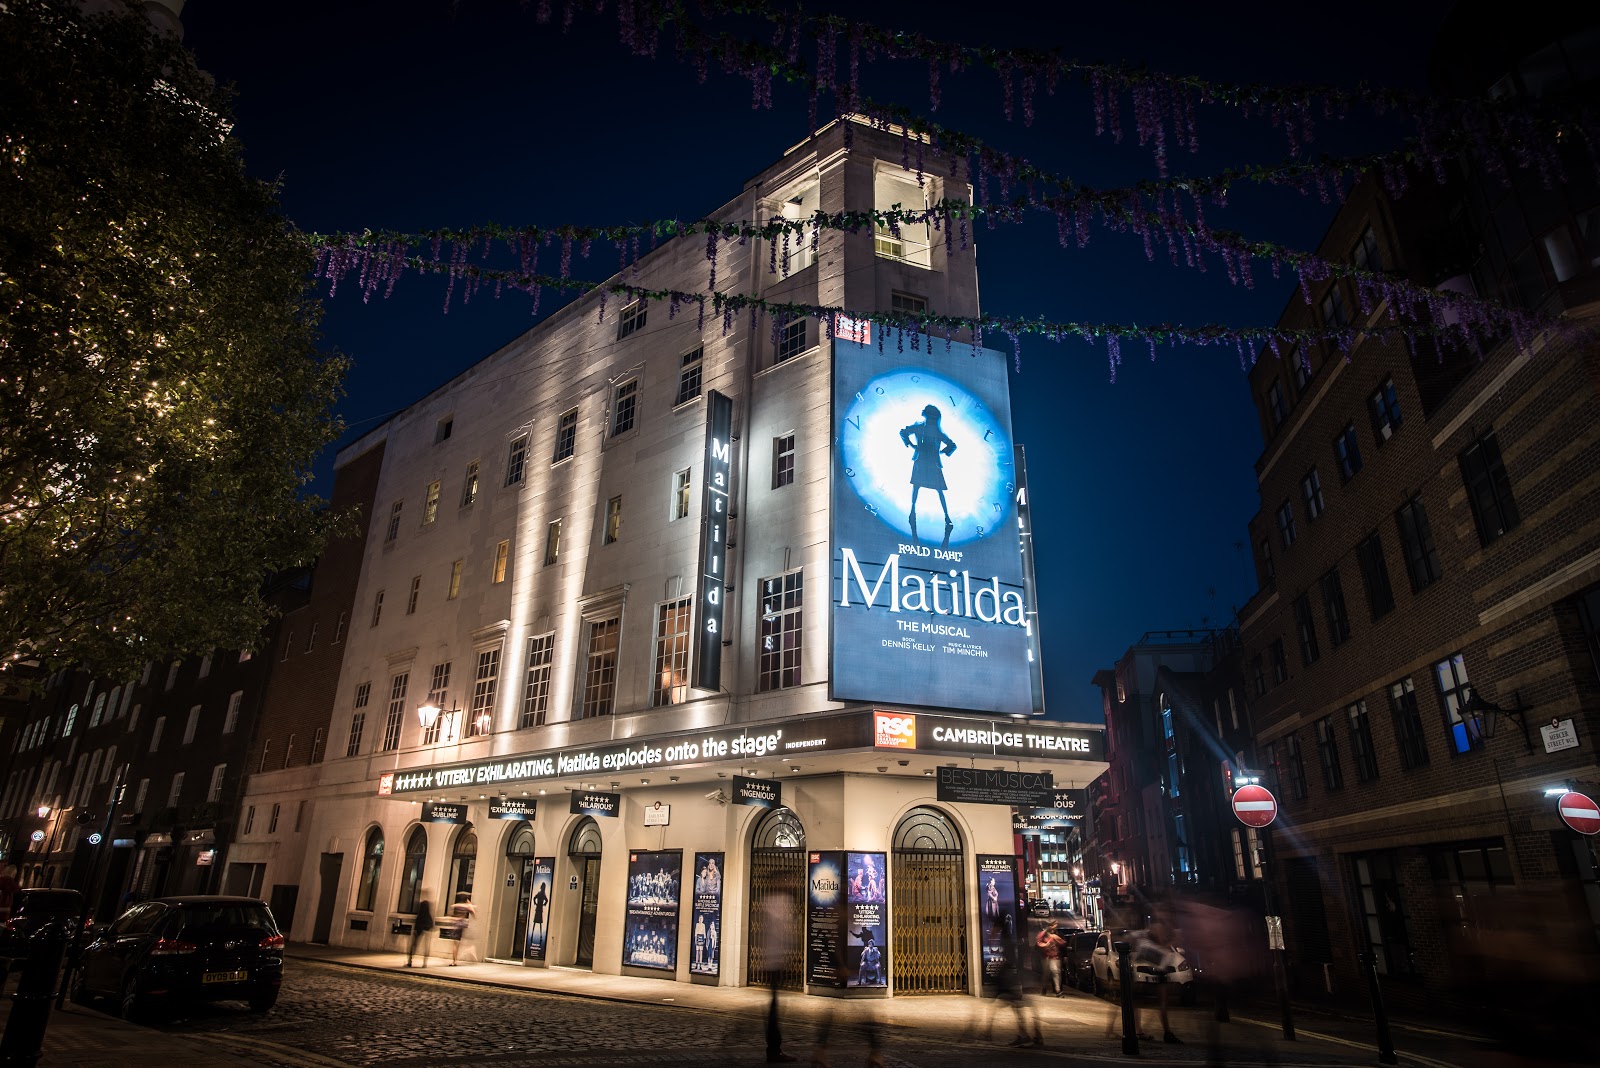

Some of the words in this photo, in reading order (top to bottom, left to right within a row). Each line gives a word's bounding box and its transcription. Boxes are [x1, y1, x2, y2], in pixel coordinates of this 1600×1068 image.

[706, 438, 730, 634] Matilda
[898, 543, 930, 557] ROALD
[839, 547, 1028, 629] Matilda
[897, 620, 919, 632] THE
[921, 623, 971, 639] MUSICAL
[881, 639, 911, 650] DENNIS
[912, 642, 935, 652] KELLY
[942, 645, 956, 655] TIM
[957, 647, 988, 658] MINCHIN
[876, 716, 912, 737] RSC
[932, 727, 1023, 748] CAMBRIDGE
[1026, 734, 1091, 753] THEATRE
[1549, 730, 1569, 741] MERCER
[785, 738, 827, 750] INDEPENDENT
[1547, 739, 1565, 749] STREET
[477, 759, 555, 782] EXHILARATING.
[558, 752, 600, 773] Matilda
[602, 745, 662, 770] explodes
[665, 742, 699, 761] onto
[702, 737, 727, 757] the
[941, 768, 981, 786] BEST
[985, 772, 1052, 790] MUSICAL
[812, 879, 839, 891] Matilda
